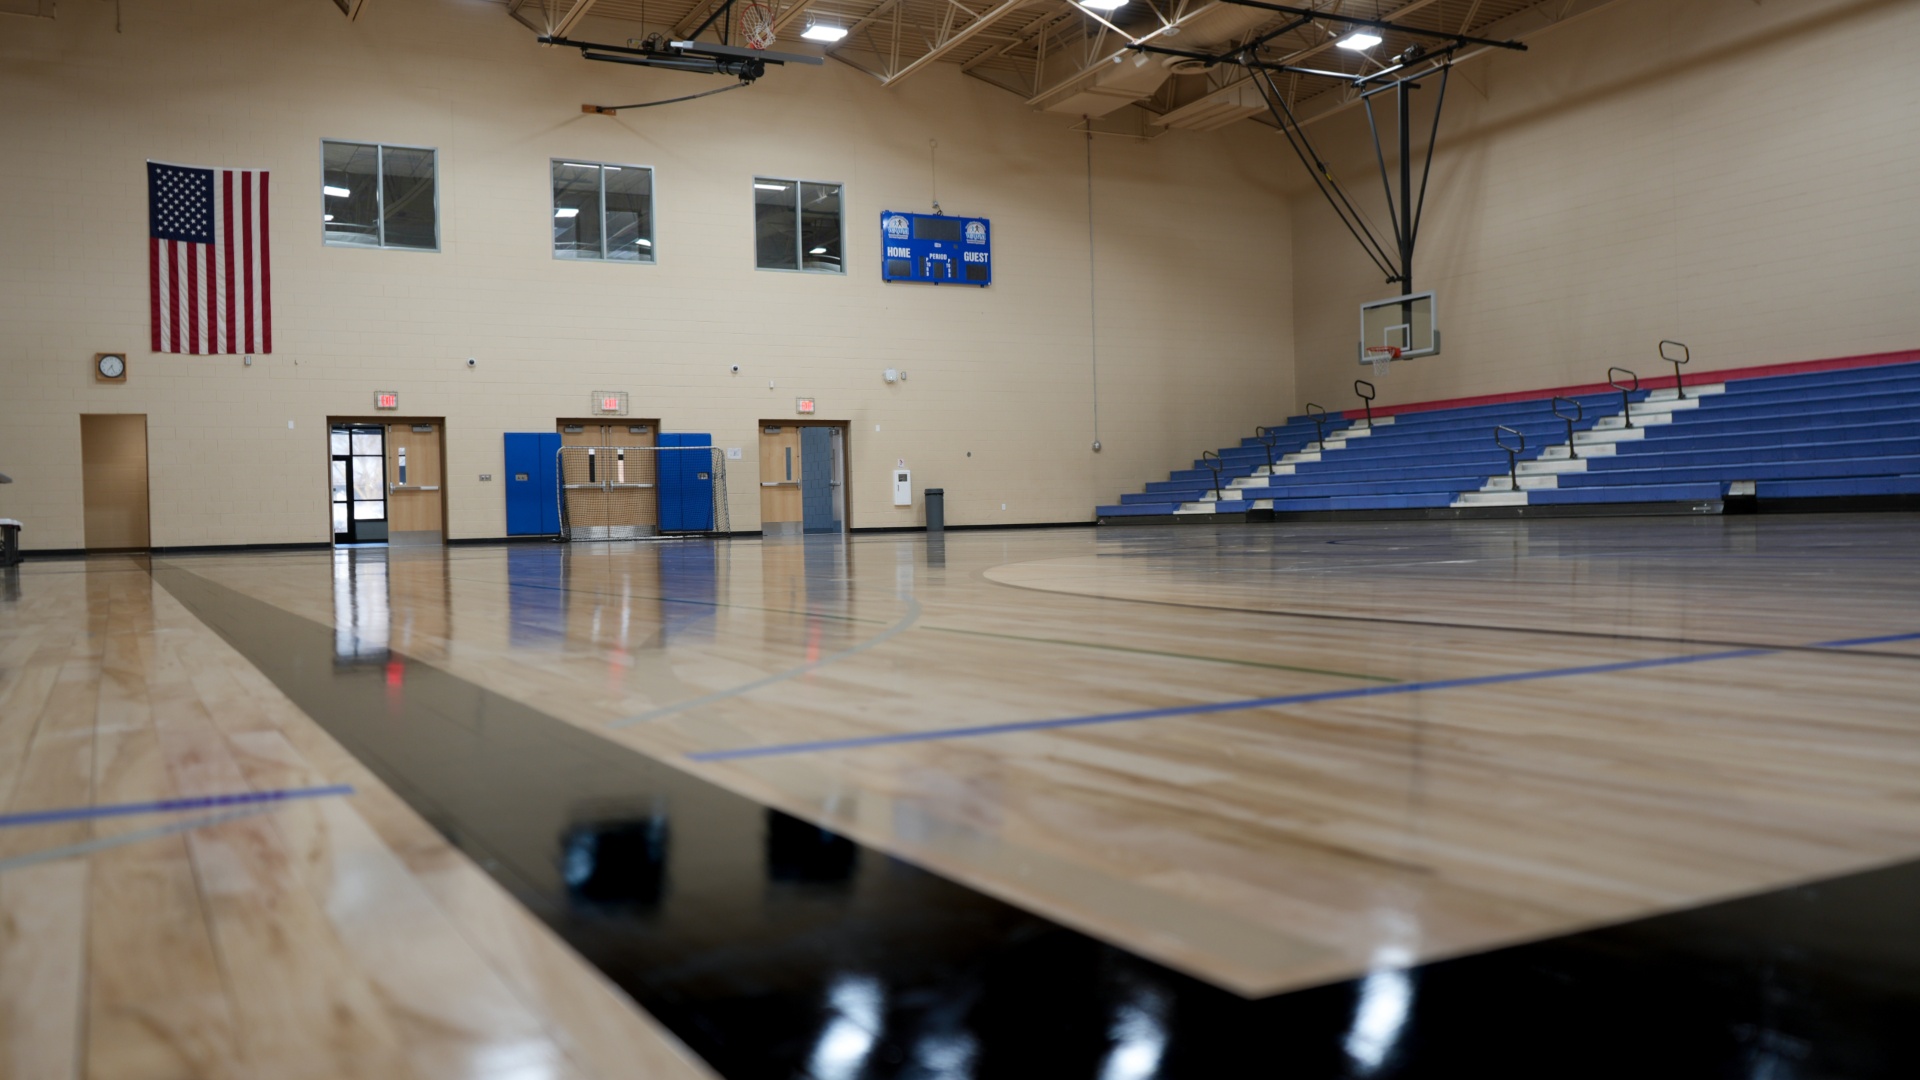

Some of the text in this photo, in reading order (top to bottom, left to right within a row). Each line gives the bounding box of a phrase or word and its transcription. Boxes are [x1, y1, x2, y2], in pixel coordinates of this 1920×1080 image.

[888, 246, 910, 258] HOME
[964, 252, 988, 262] GUEST
[381, 396, 394, 406] EXIT
